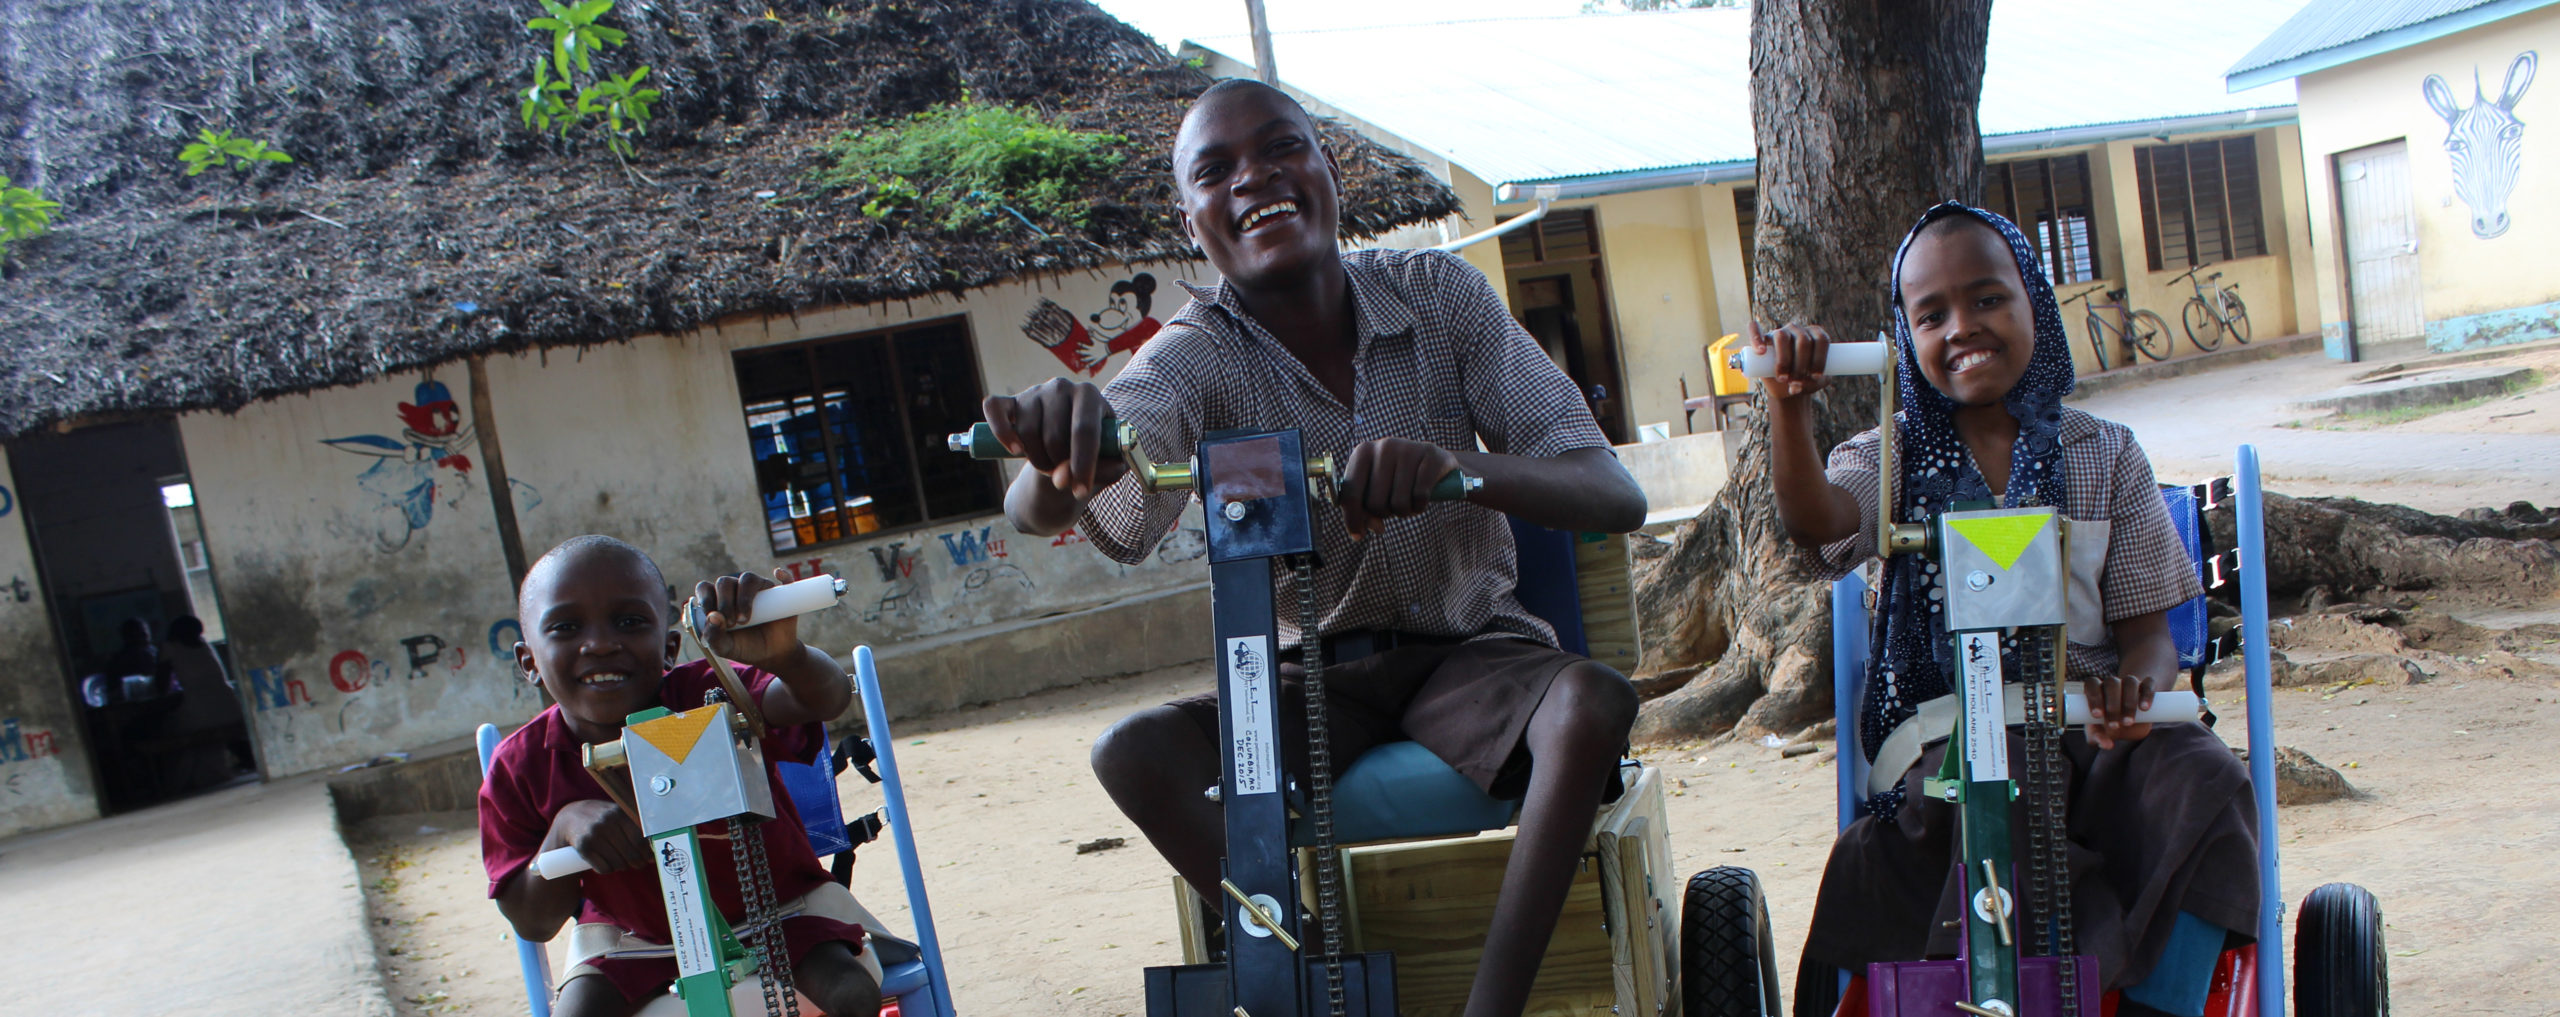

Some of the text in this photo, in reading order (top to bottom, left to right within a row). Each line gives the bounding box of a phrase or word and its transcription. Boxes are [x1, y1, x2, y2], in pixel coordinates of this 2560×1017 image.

[250, 664, 312, 712] Nn
[1970, 693, 1978, 735] HOLLAND
[1248, 777, 1255, 791] MO
[669, 890, 677, 906] PET
[672, 907, 685, 948] HOLLAND
[680, 949, 689, 970] 2532
